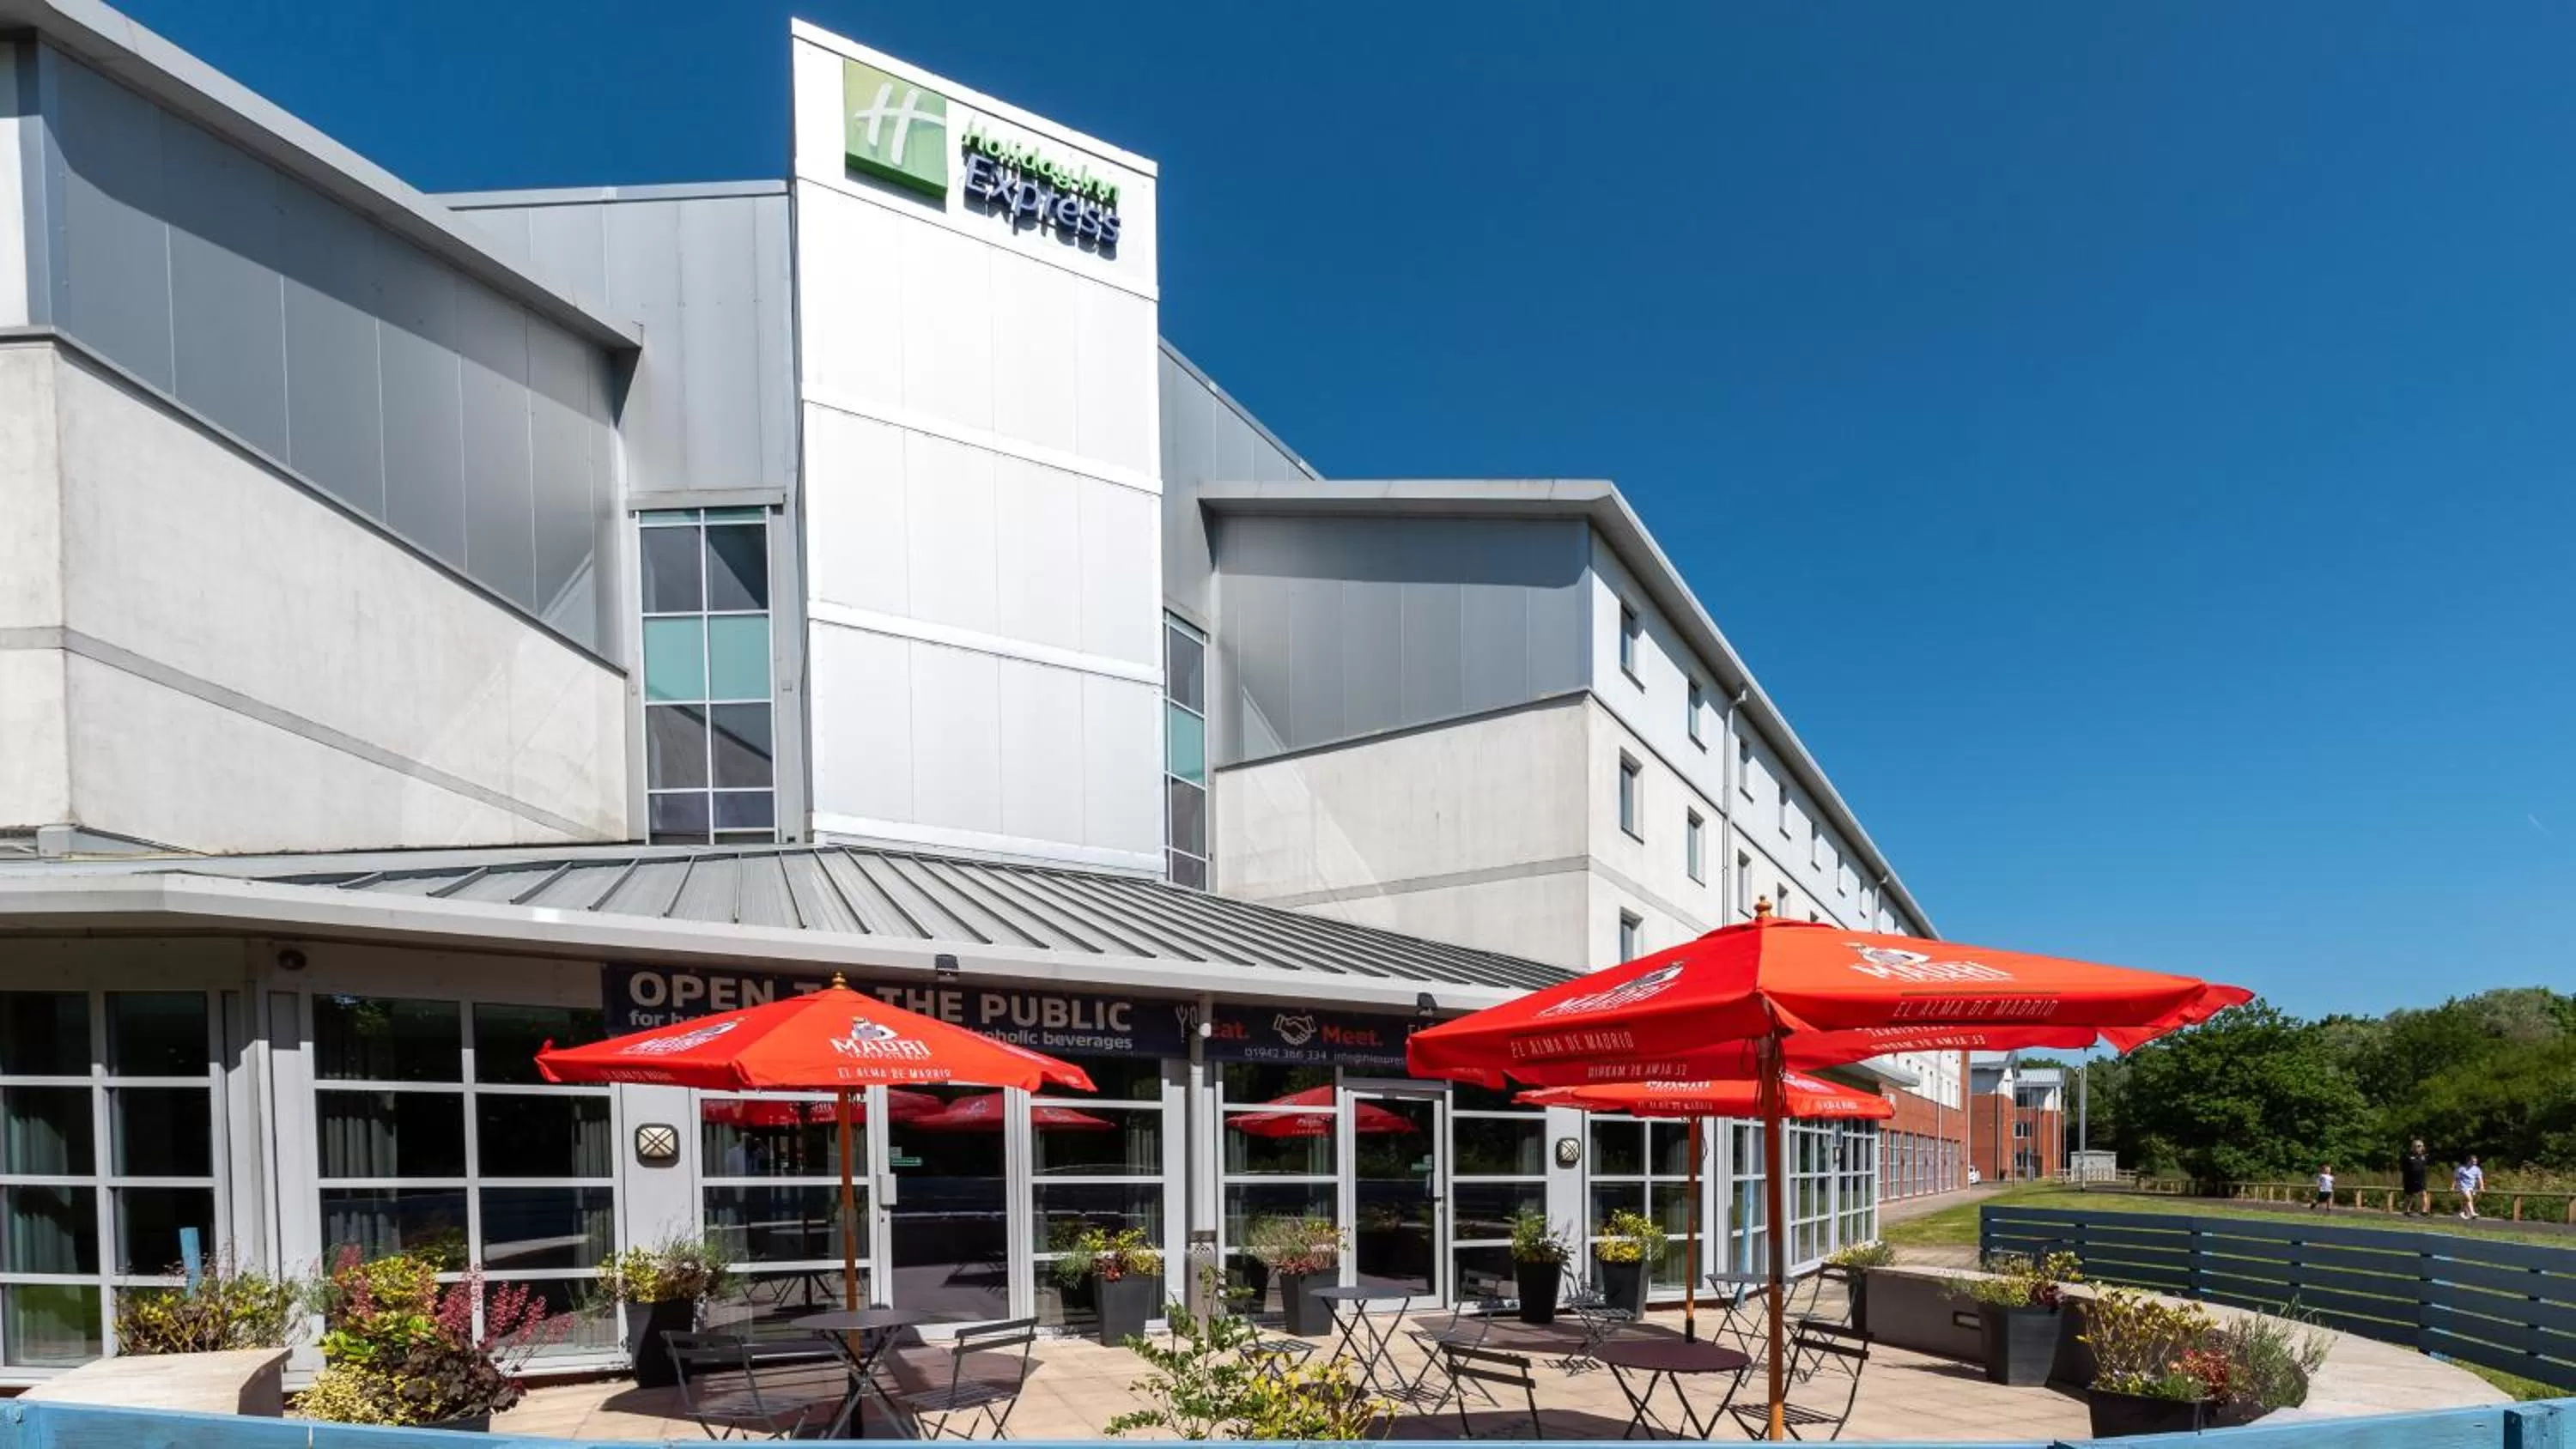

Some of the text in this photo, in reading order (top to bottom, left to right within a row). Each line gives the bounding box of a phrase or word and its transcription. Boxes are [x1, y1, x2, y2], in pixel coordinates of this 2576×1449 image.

[962, 117, 1120, 203] Holiday Inn
[965, 152, 1121, 241] Express
[629, 971, 775, 1010] OPEN
[875, 986, 963, 1023] THE
[981, 992, 1133, 1032] PUBLIC
[1893, 998, 2058, 1017] EL ALMA DE MADRID
[628, 1009, 664, 1027] for
[1043, 1031, 1133, 1052] beverages
[1321, 1025, 1384, 1047] Meet.
[1511, 1032, 1634, 1058] EL ALMA DE MADRID
